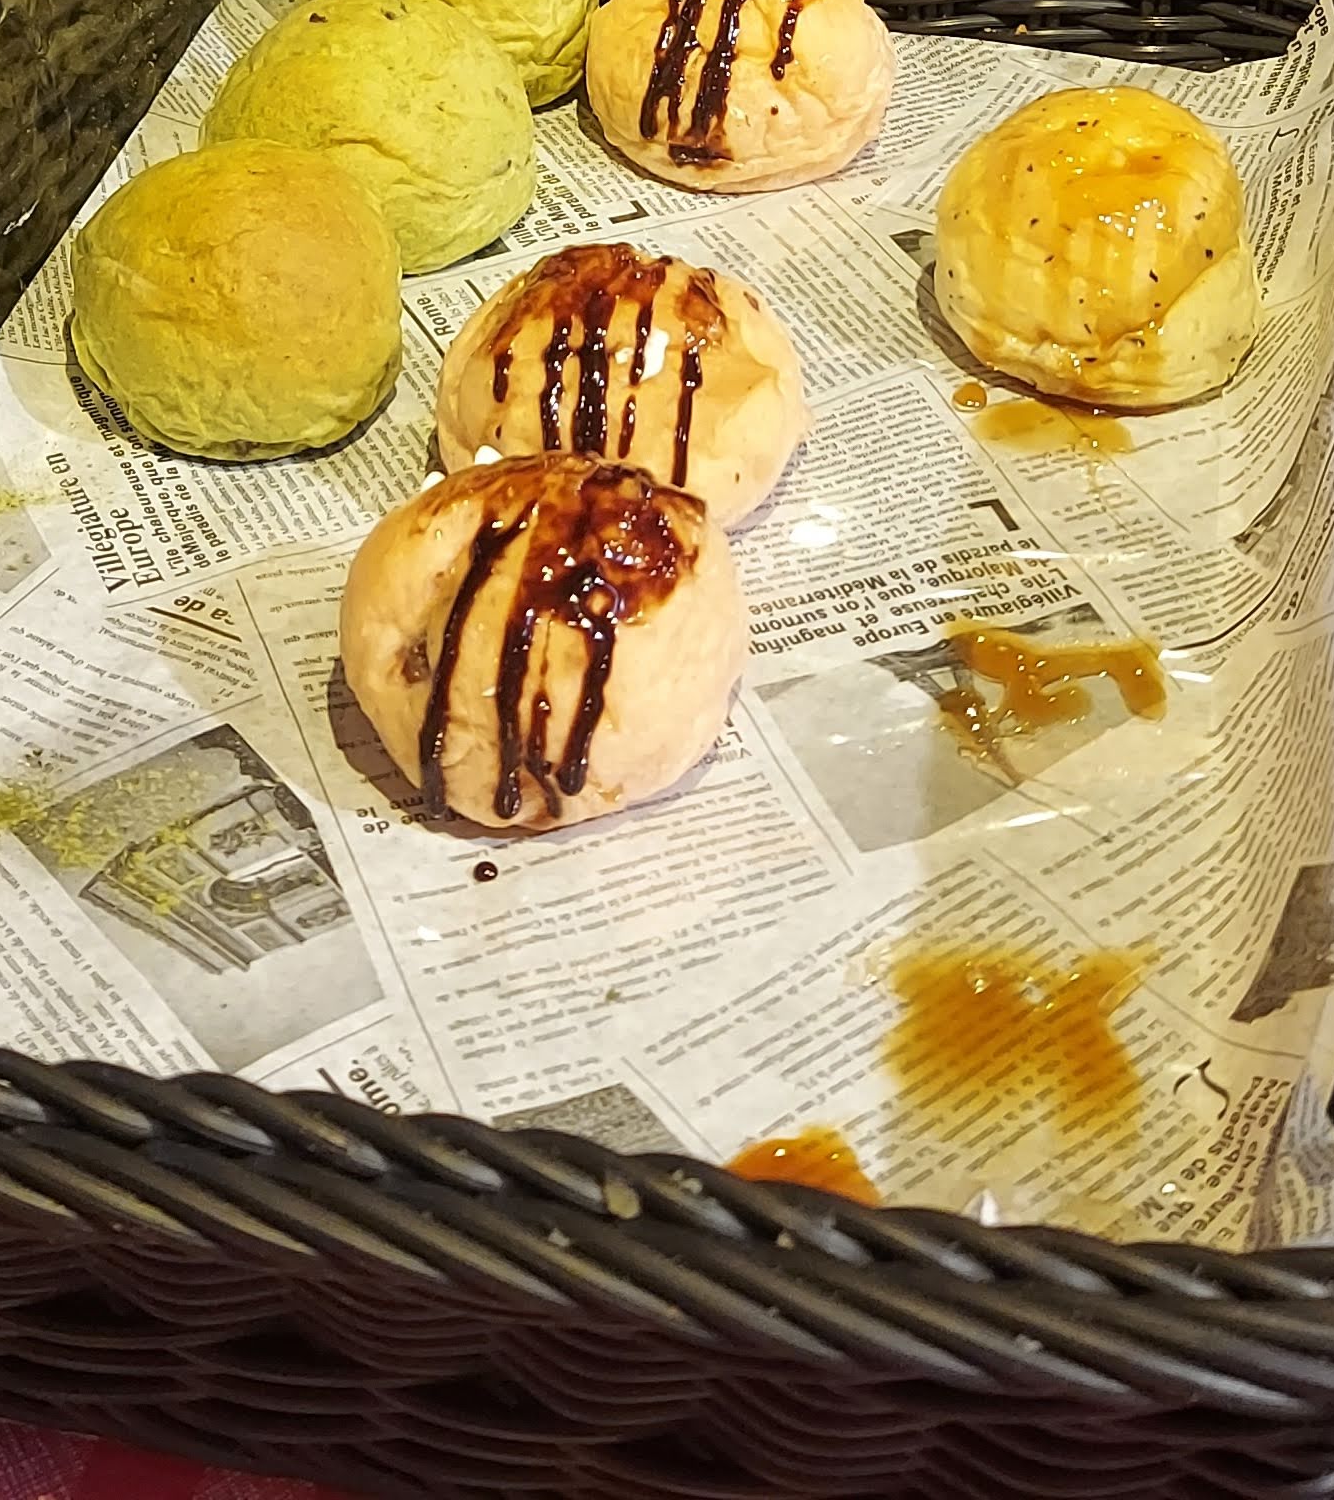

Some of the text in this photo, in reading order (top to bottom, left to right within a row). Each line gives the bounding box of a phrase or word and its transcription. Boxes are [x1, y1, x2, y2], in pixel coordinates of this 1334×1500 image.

[122, 434, 148, 459] l'on
[69, 376, 191, 577] L'île chaleureuse et magnifique
[141, 460, 165, 486] que
[165, 466, 181, 480] la
[45, 452, 132, 593] Villégiature en
[185, 503, 226, 548] paradis
[109, 507, 165, 588] Europe
[1017, 537, 1040, 550] le
[192, 553, 211, 569] de
[215, 549, 232, 563] le
[888, 568, 909, 580] la
[911, 559, 937, 573] de
[748, 574, 883, 615] Méditerranée
[877, 582, 915, 601] que
[173, 595, 206, 613] de
[832, 596, 873, 614] l'on
[855, 613, 878, 629] et
[852, 619, 928, 647] Europe
[355, 806, 377, 818] le
[363, 820, 390, 834] de
[349, 1059, 400, 1119] ome.
